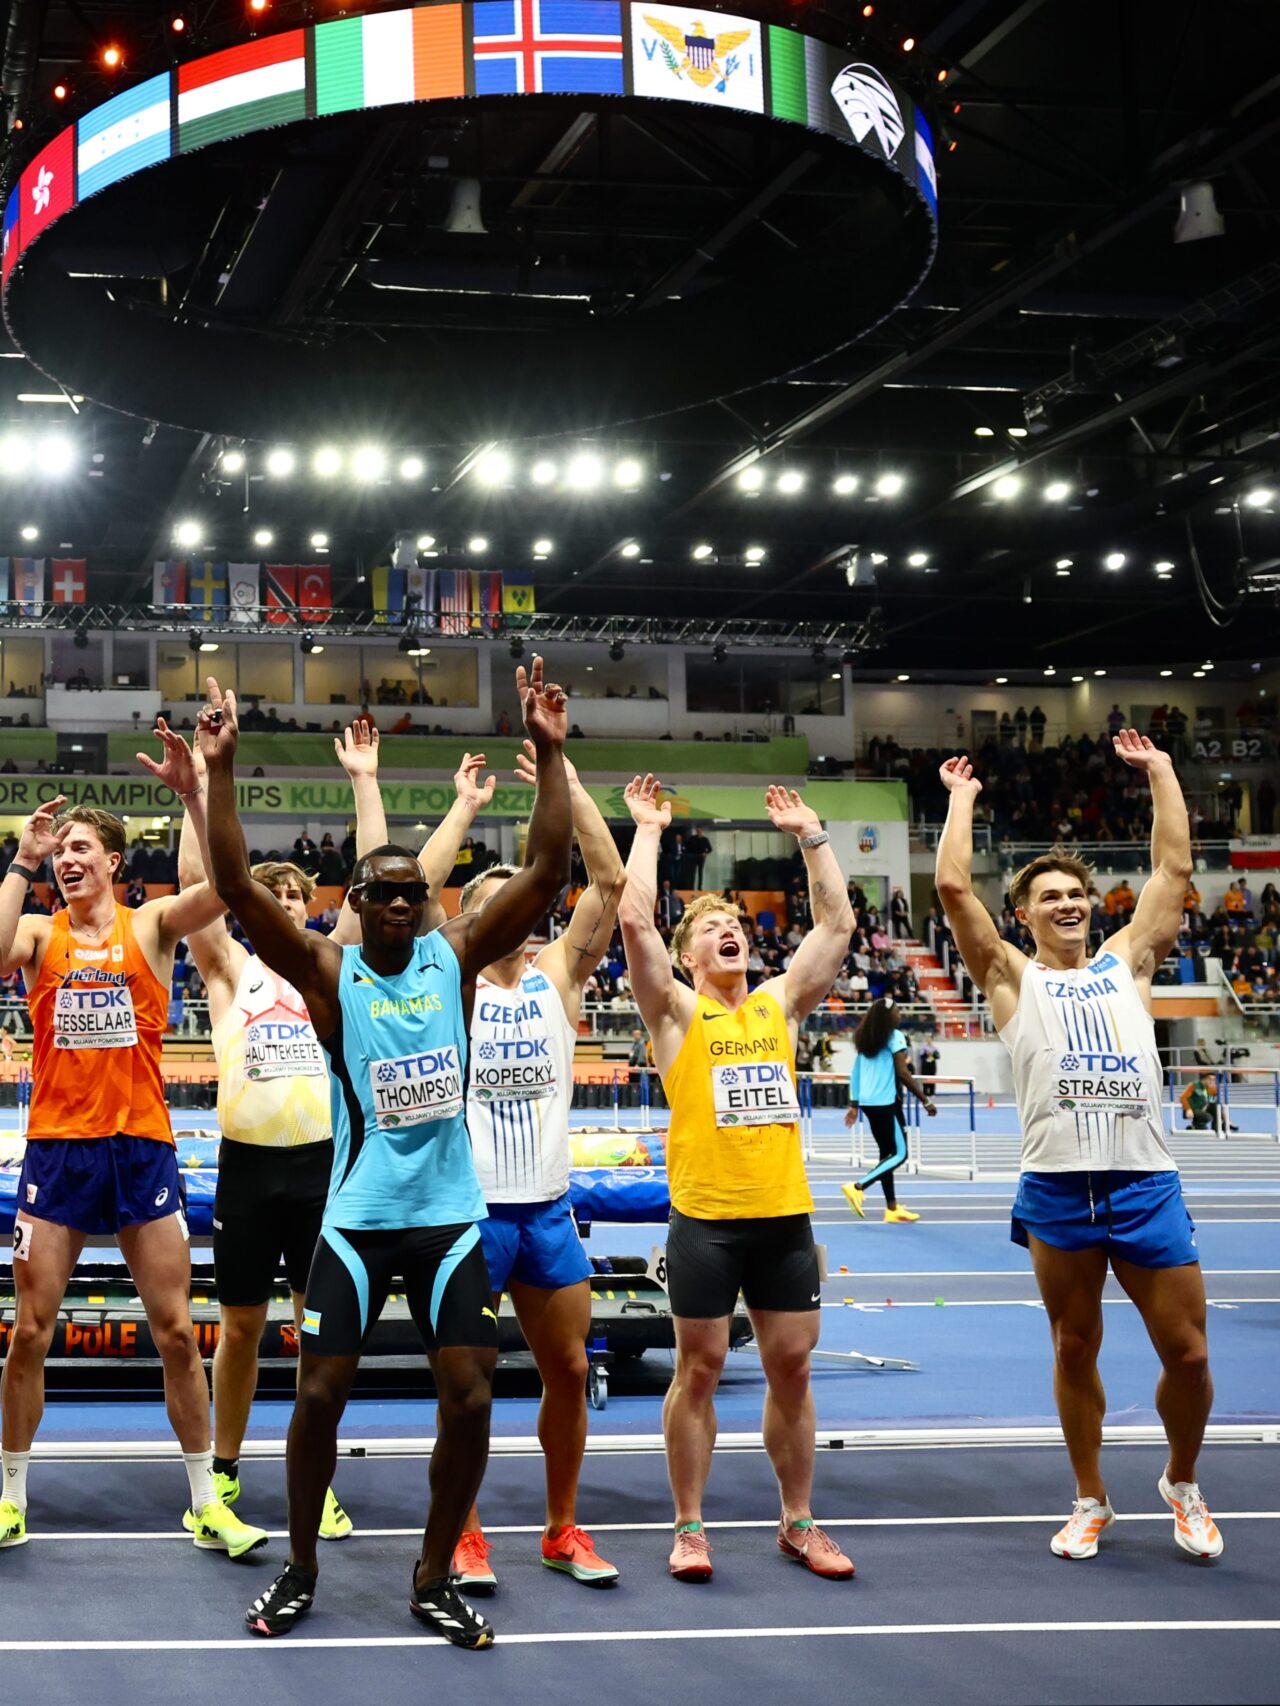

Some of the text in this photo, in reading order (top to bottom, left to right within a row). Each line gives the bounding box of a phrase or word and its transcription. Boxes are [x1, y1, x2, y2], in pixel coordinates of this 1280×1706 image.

[1194, 740, 1222, 758] A2
[1231, 739, 1262, 757] B2
[37, 782, 282, 808] CHAMPIOIPS
[290, 785, 403, 810] KUJAY
[409, 787, 536, 812] PORZE
[72, 990, 127, 1009] TDK
[370, 993, 443, 1020] BAHAMAS
[57, 1011, 133, 1033] TESSELAAR
[260, 1024, 312, 1040] TDK
[245, 1043, 319, 1065] HAUTTEKEETE
[496, 1038, 550, 1061] TDK
[395, 1050, 456, 1080] TDK
[475, 1060, 554, 1086] KOPECKÝ
[737, 1064, 788, 1084] TDK
[1079, 1054, 1140, 1074] TDK
[376, 1074, 460, 1110] THOMPSON
[728, 1087, 790, 1109] EITEL
[1058, 1076, 1142, 1098] STRÁSKÝ
[405, 1111, 432, 1122] KUJAWY
[64, 1321, 138, 1358] POLE
